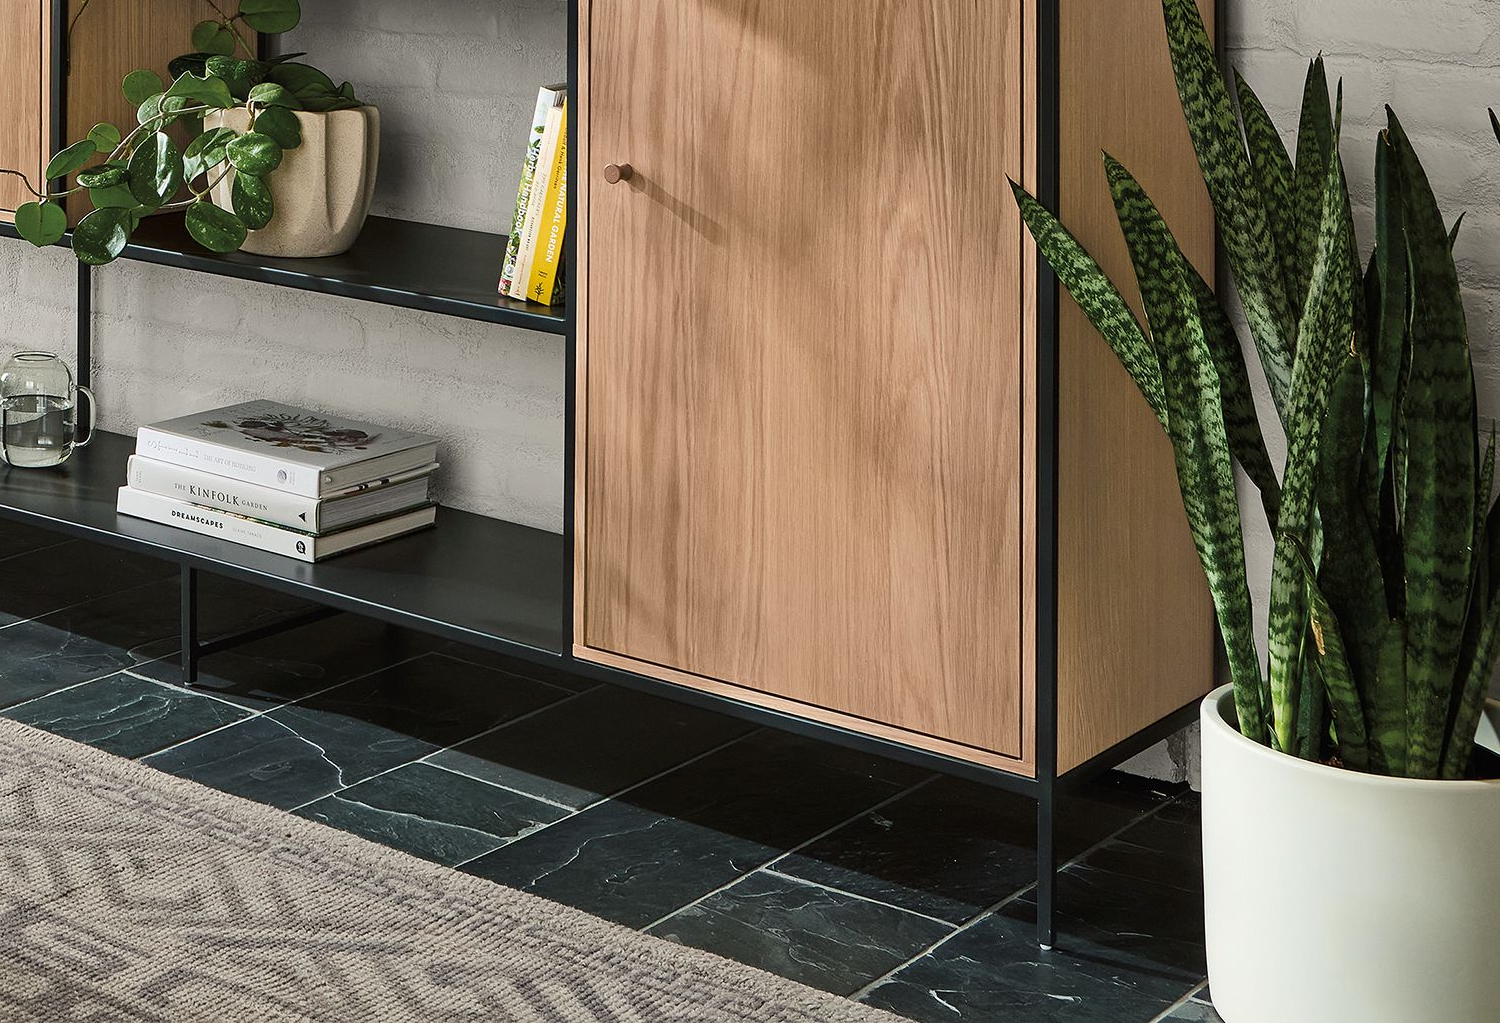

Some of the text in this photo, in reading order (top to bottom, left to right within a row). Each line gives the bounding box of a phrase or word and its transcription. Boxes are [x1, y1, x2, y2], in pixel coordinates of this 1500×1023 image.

[515, 182, 532, 236] Handbook
[553, 181, 567, 224] NATURAL
[545, 224, 559, 263] GARDEN
[174, 483, 268, 511] THE KINFOLK GARDEN
[171, 510, 224, 529] DREAMSCAPES
